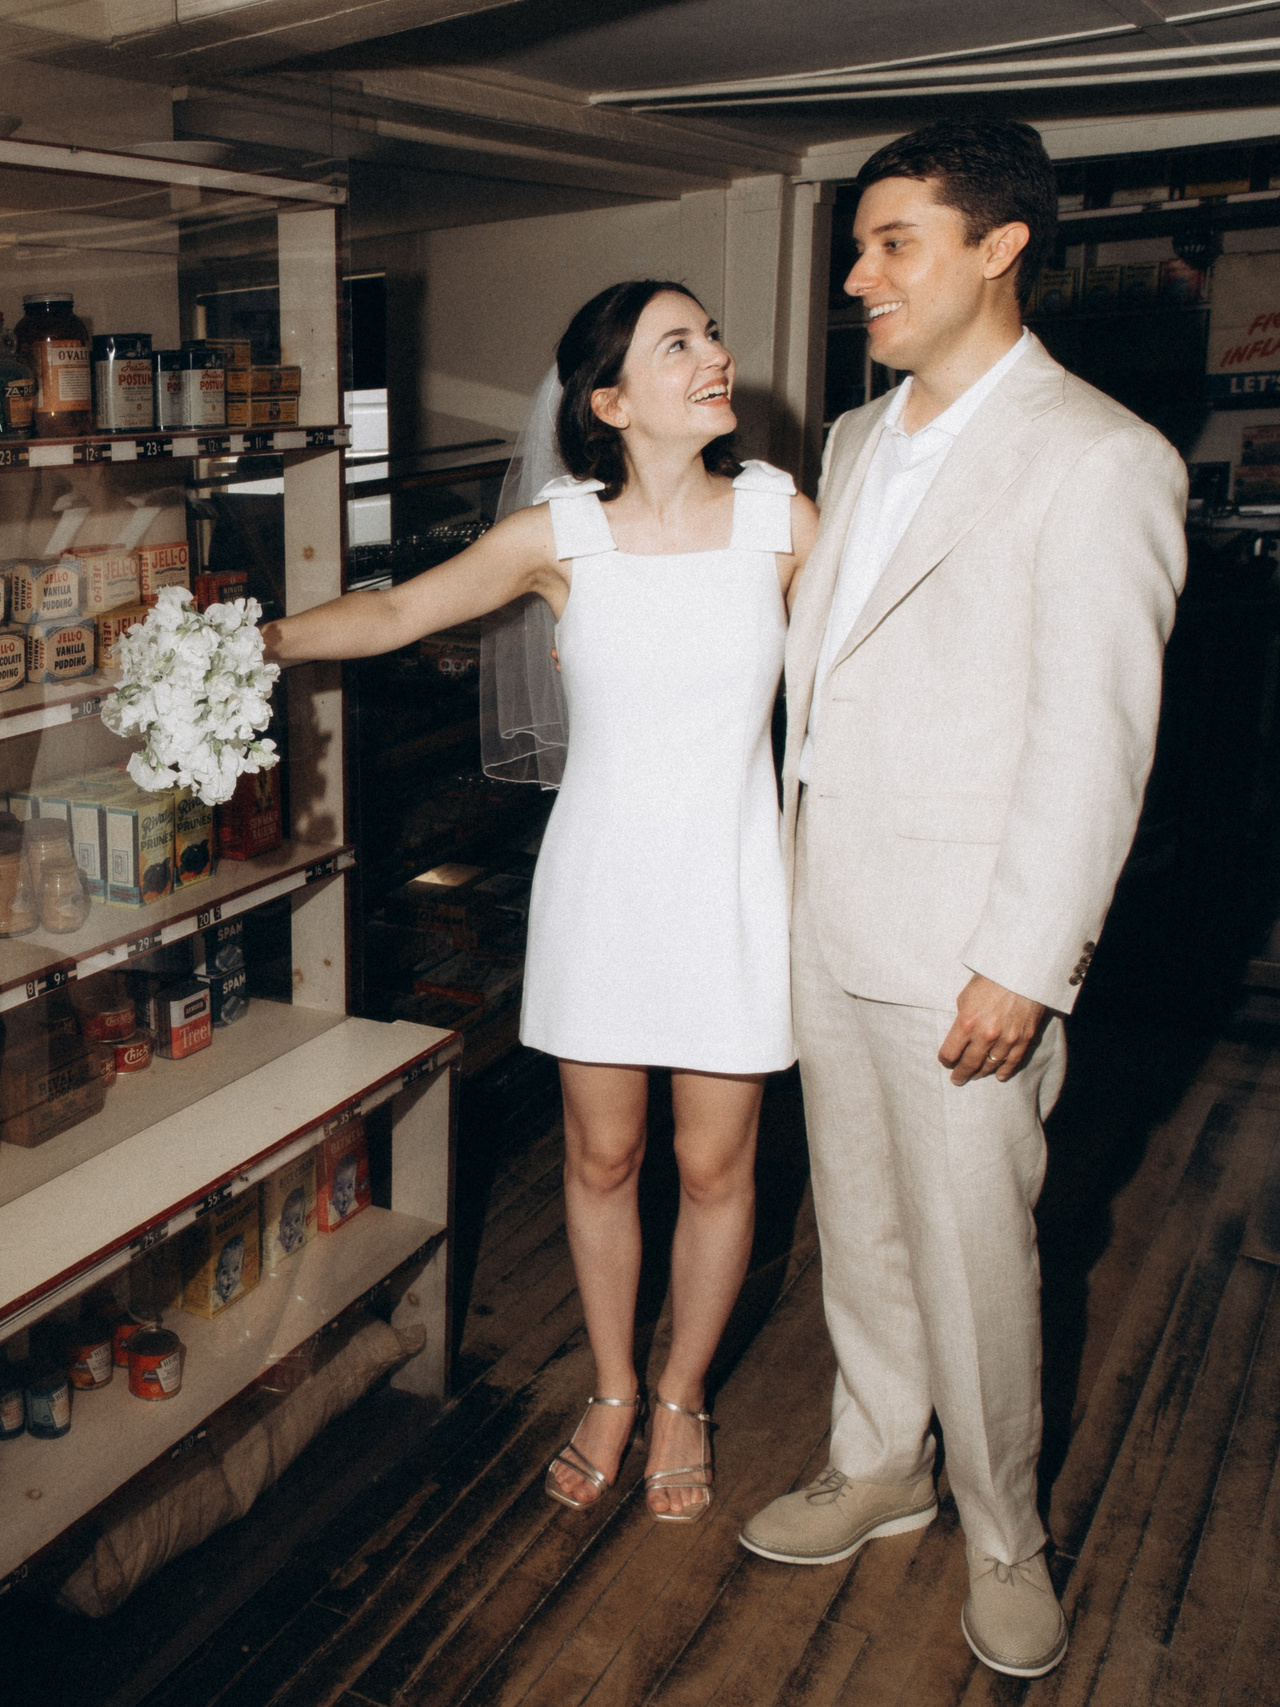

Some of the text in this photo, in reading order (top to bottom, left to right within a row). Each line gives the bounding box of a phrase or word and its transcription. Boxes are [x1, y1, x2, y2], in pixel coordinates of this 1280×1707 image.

[4, 385, 36, 398] ZA-RE
[152, 547, 188, 569] JELL-O
[43, 584, 72, 598] VANILLA
[42, 598, 73, 611] PUDDING
[57, 630, 83, 644] JELL-O
[55, 643, 85, 657] VANILLA
[54, 655, 87, 671] PUDDING
[177, 812, 213, 833] PRUNES
[141, 832, 175, 852] PRUNES
[218, 921, 244, 942] SPAM
[223, 972, 247, 995] SPAM
[124, 1044, 150, 1064] Chick
